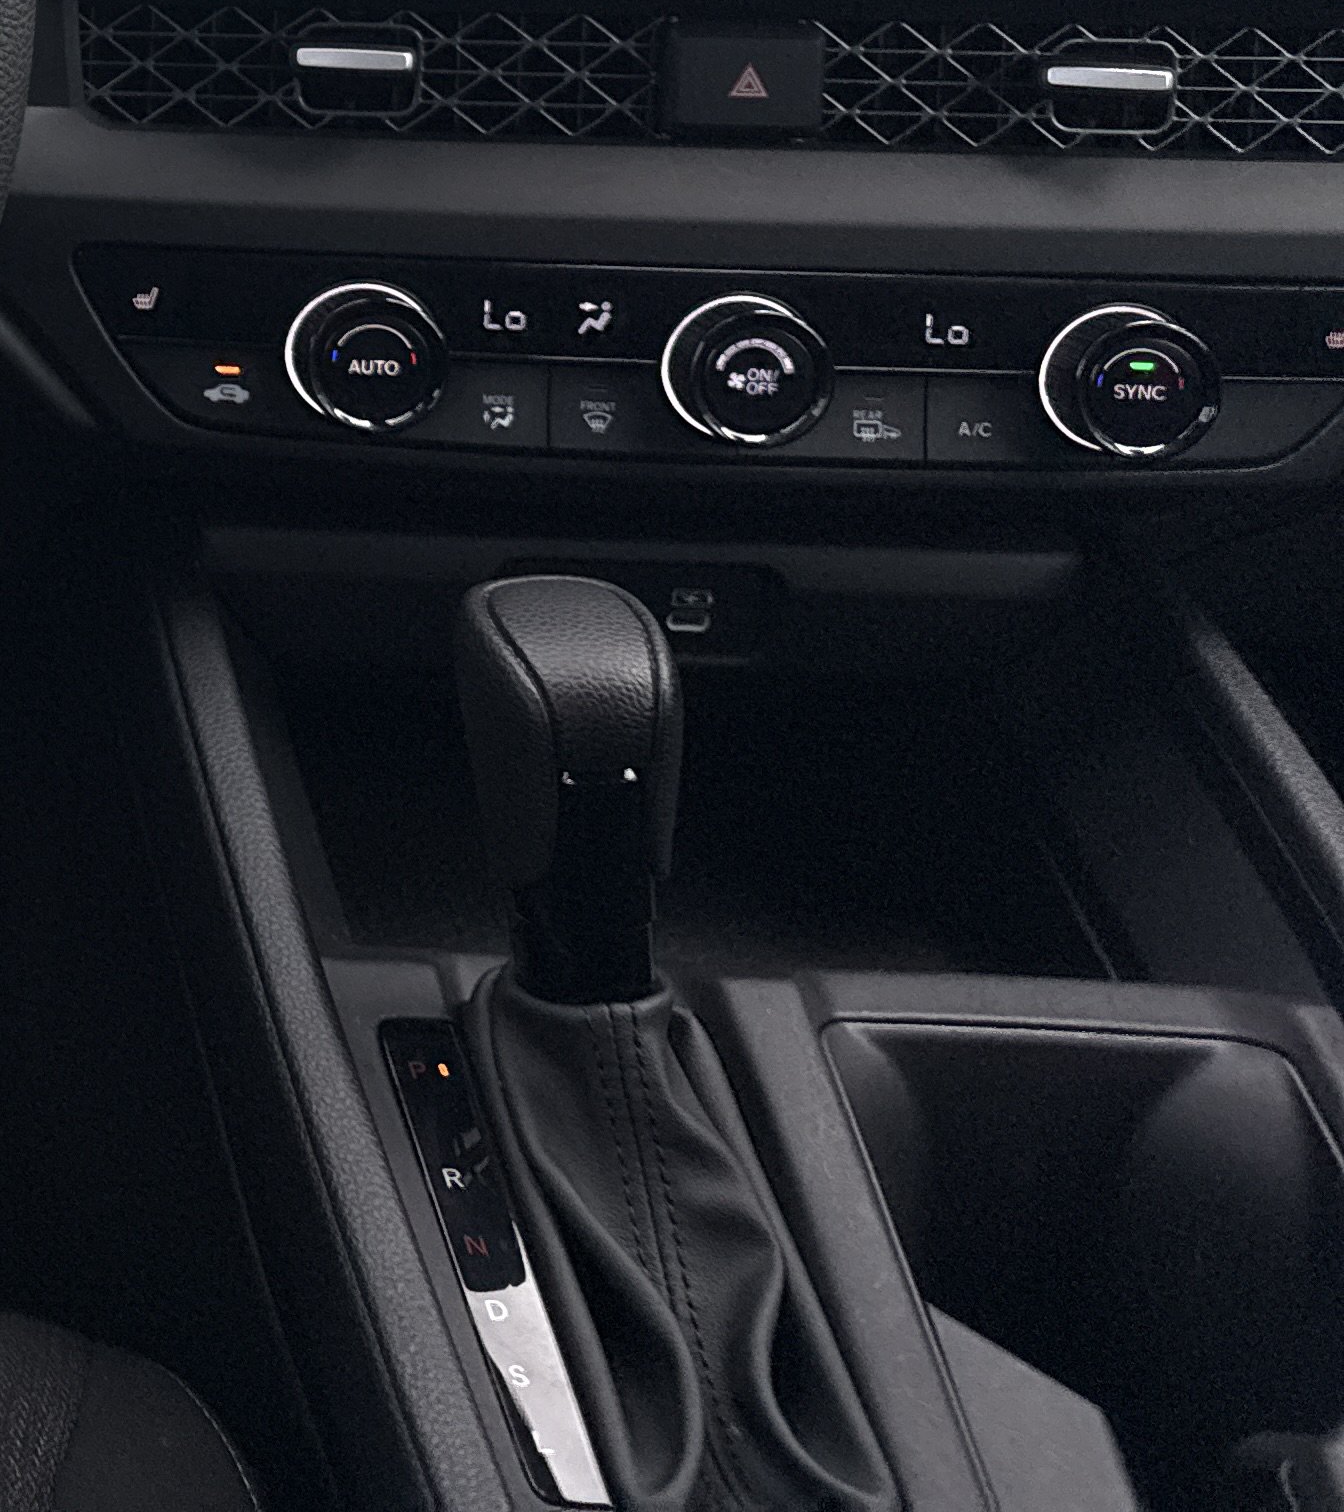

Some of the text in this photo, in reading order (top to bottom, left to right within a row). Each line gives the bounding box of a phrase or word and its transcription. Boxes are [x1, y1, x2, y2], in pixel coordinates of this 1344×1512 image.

[348, 359, 401, 377] AUTO
[746, 382, 778, 396] OFF
[1113, 383, 1168, 402] SYNC
[483, 395, 513, 405] MODE
[580, 400, 617, 412] FRONT
[958, 421, 992, 438] A/C
[408, 1061, 426, 1079] P
[441, 1167, 465, 1189] R
[463, 1235, 489, 1257] N
[484, 1299, 508, 1322] D
[508, 1364, 530, 1388] S
[532, 1429, 555, 1455] L
